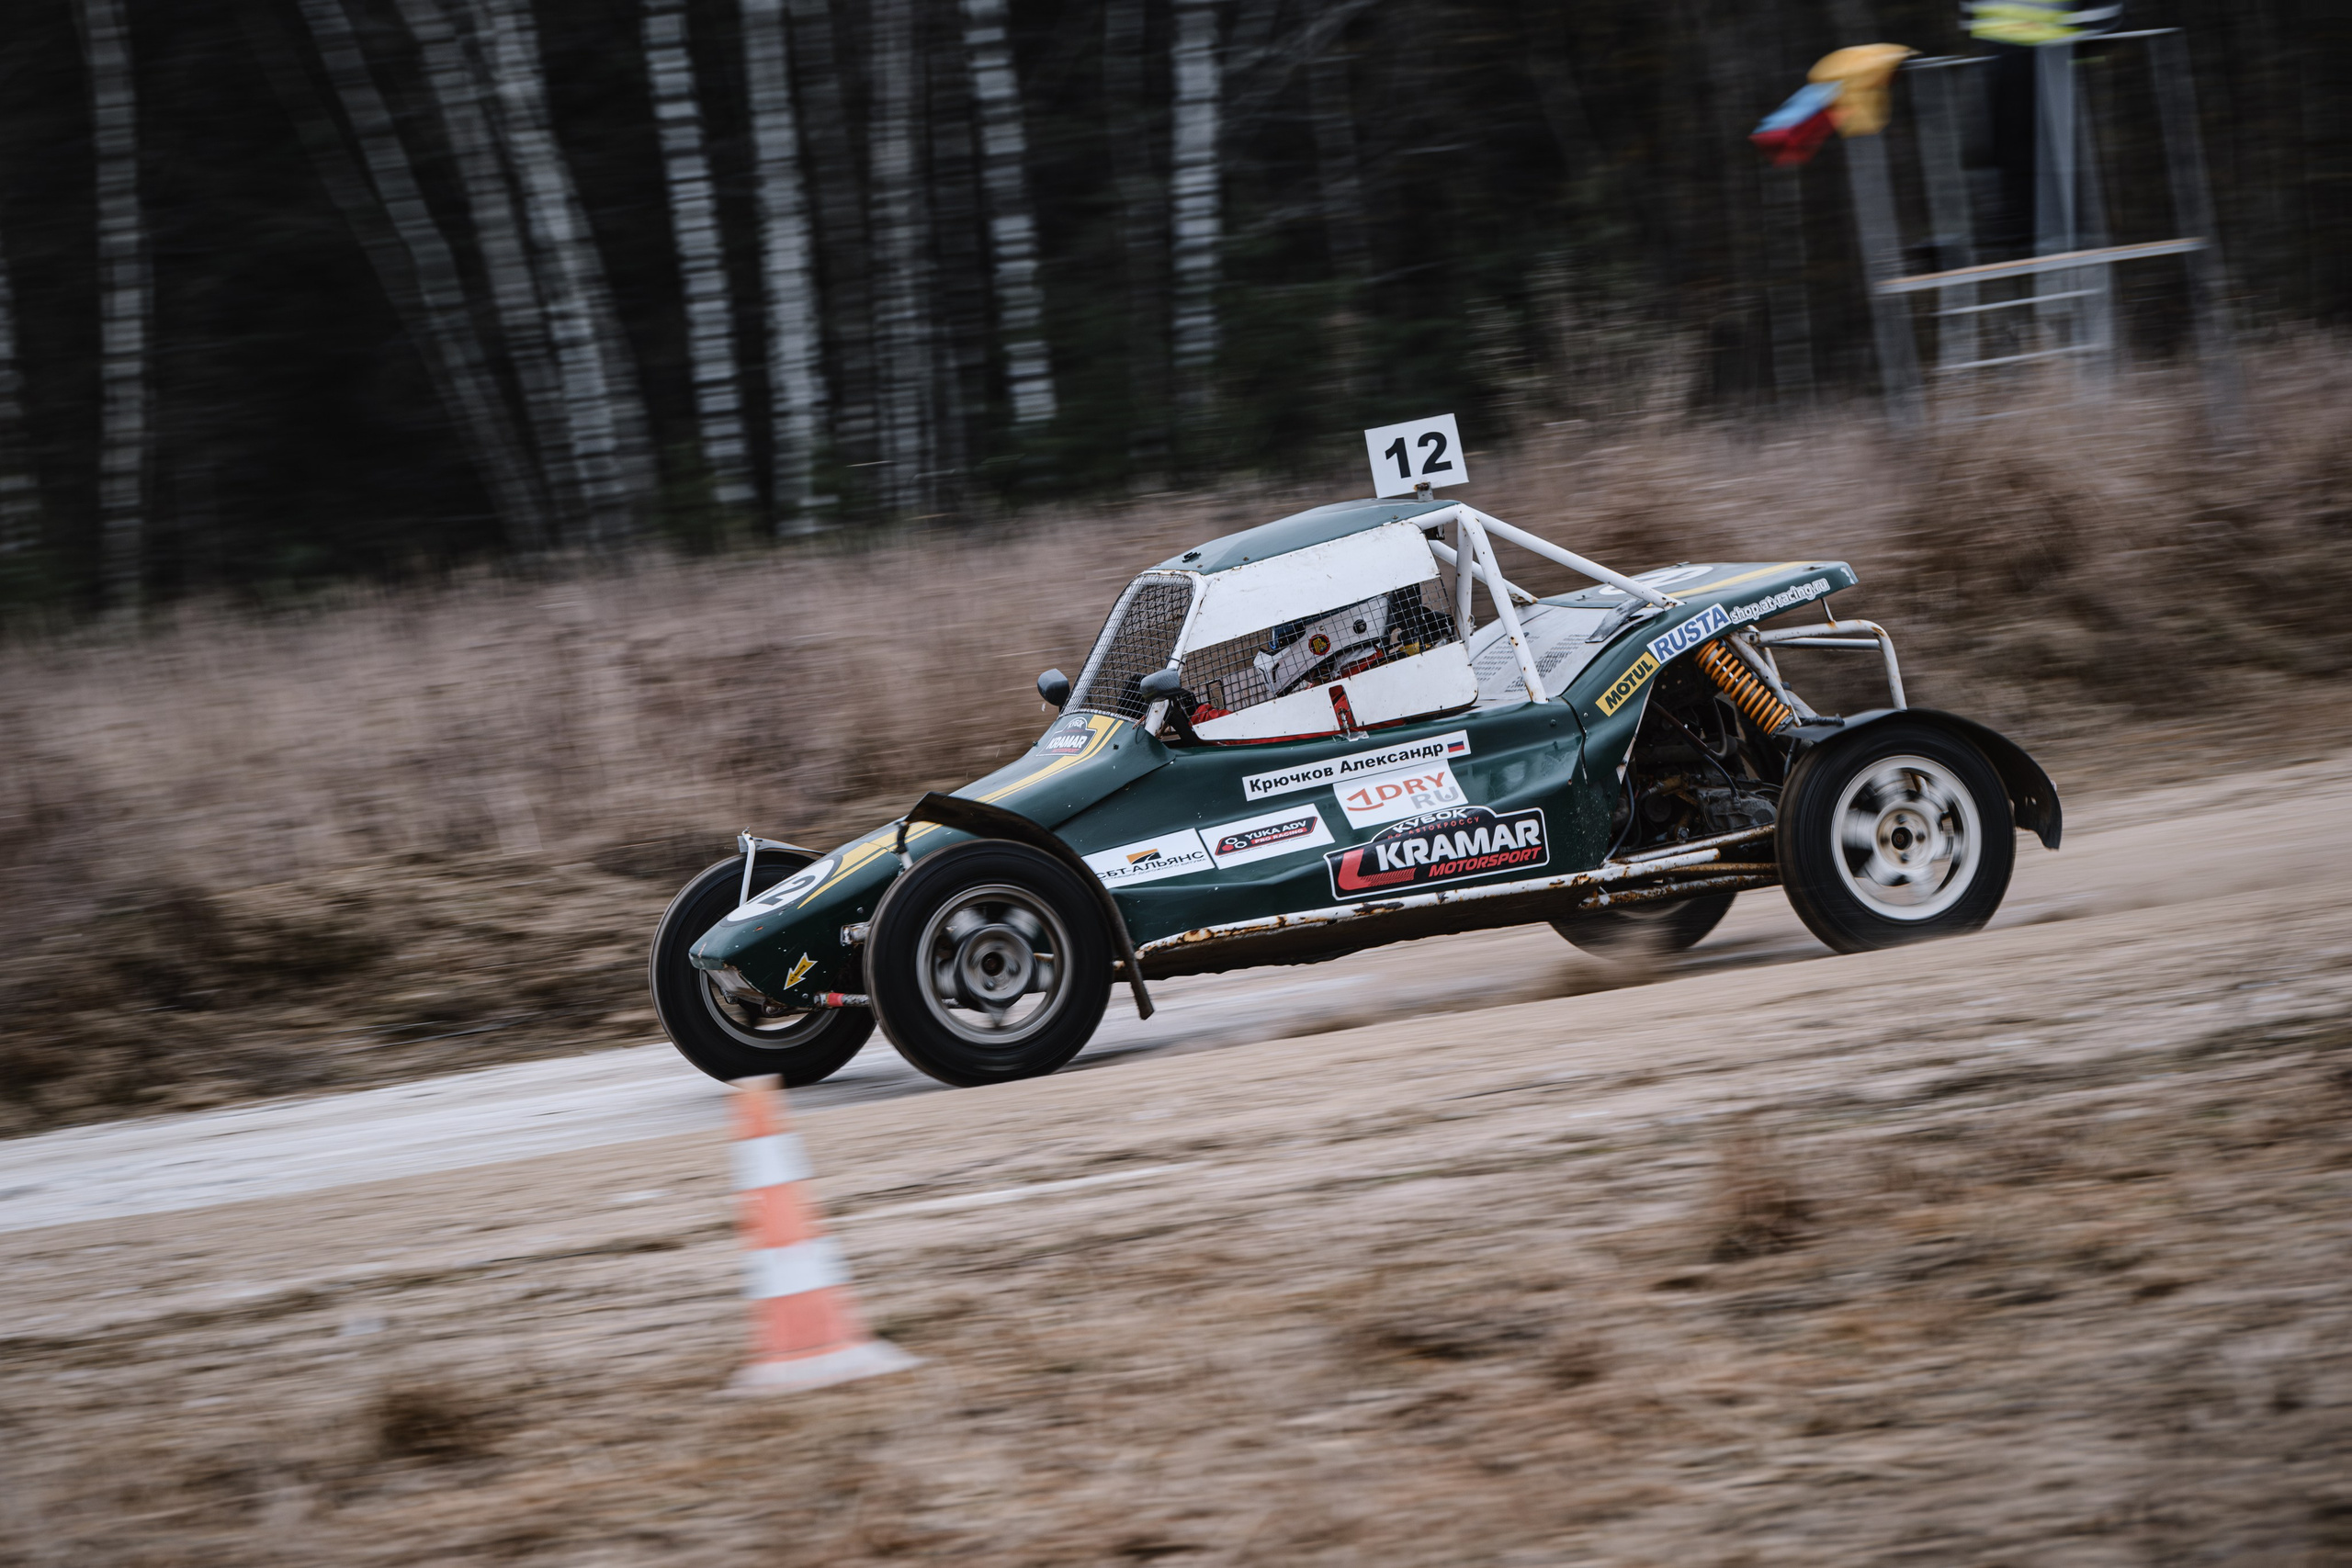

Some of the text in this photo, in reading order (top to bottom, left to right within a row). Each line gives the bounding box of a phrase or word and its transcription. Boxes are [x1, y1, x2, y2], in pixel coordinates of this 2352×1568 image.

[1385, 432, 1453, 479] 12
[1654, 607, 1730, 661] RUSTA
[1604, 660, 1653, 710] MOTUL
[1250, 743, 1444, 793] Крючков Александр
[1244, 820, 1306, 840] YUKA ADV
[1376, 818, 1543, 871] KRAMAR
[1392, 808, 1468, 833] КУБОК
[1429, 846, 1543, 877] MOTORSPORT
